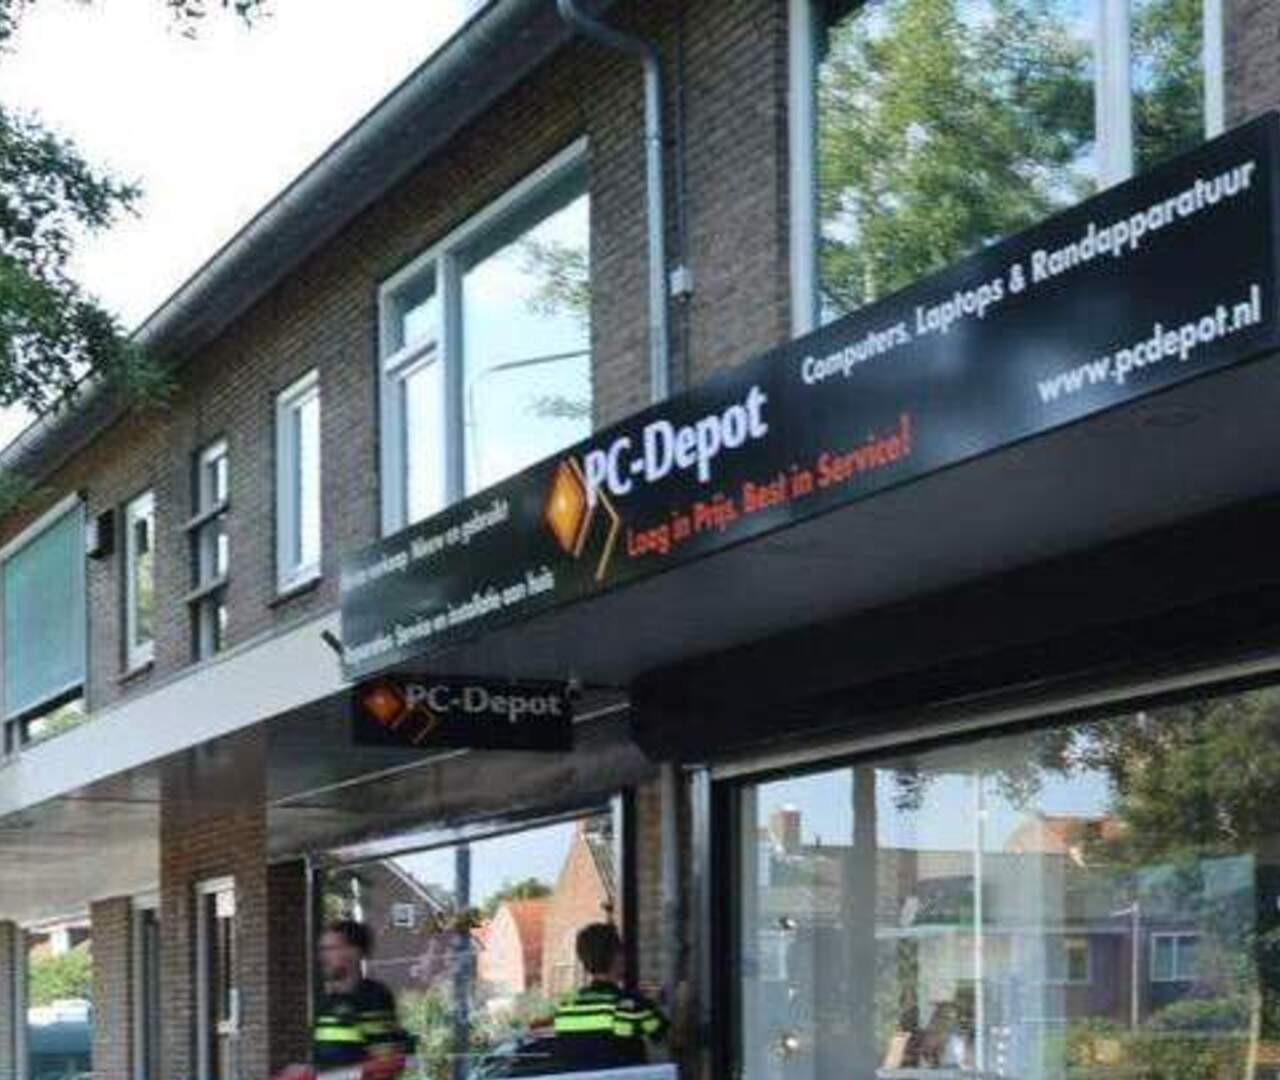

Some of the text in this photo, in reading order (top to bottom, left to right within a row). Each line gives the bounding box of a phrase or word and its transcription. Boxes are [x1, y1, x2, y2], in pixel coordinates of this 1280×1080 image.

[915, 277, 1005, 335] Laptops
[1009, 263, 1026, 294] &
[1030, 160, 1256, 284] Randapparatuur
[1036, 284, 1262, 403] www.pcdepot.nl
[585, 385, 769, 508] PC-Depot
[626, 523, 671, 556] Laag
[671, 511, 691, 541] in
[743, 473, 787, 513] Best
[791, 464, 813, 499] in
[816, 413, 913, 488] Service!
[405, 683, 562, 723] PC-Depot
